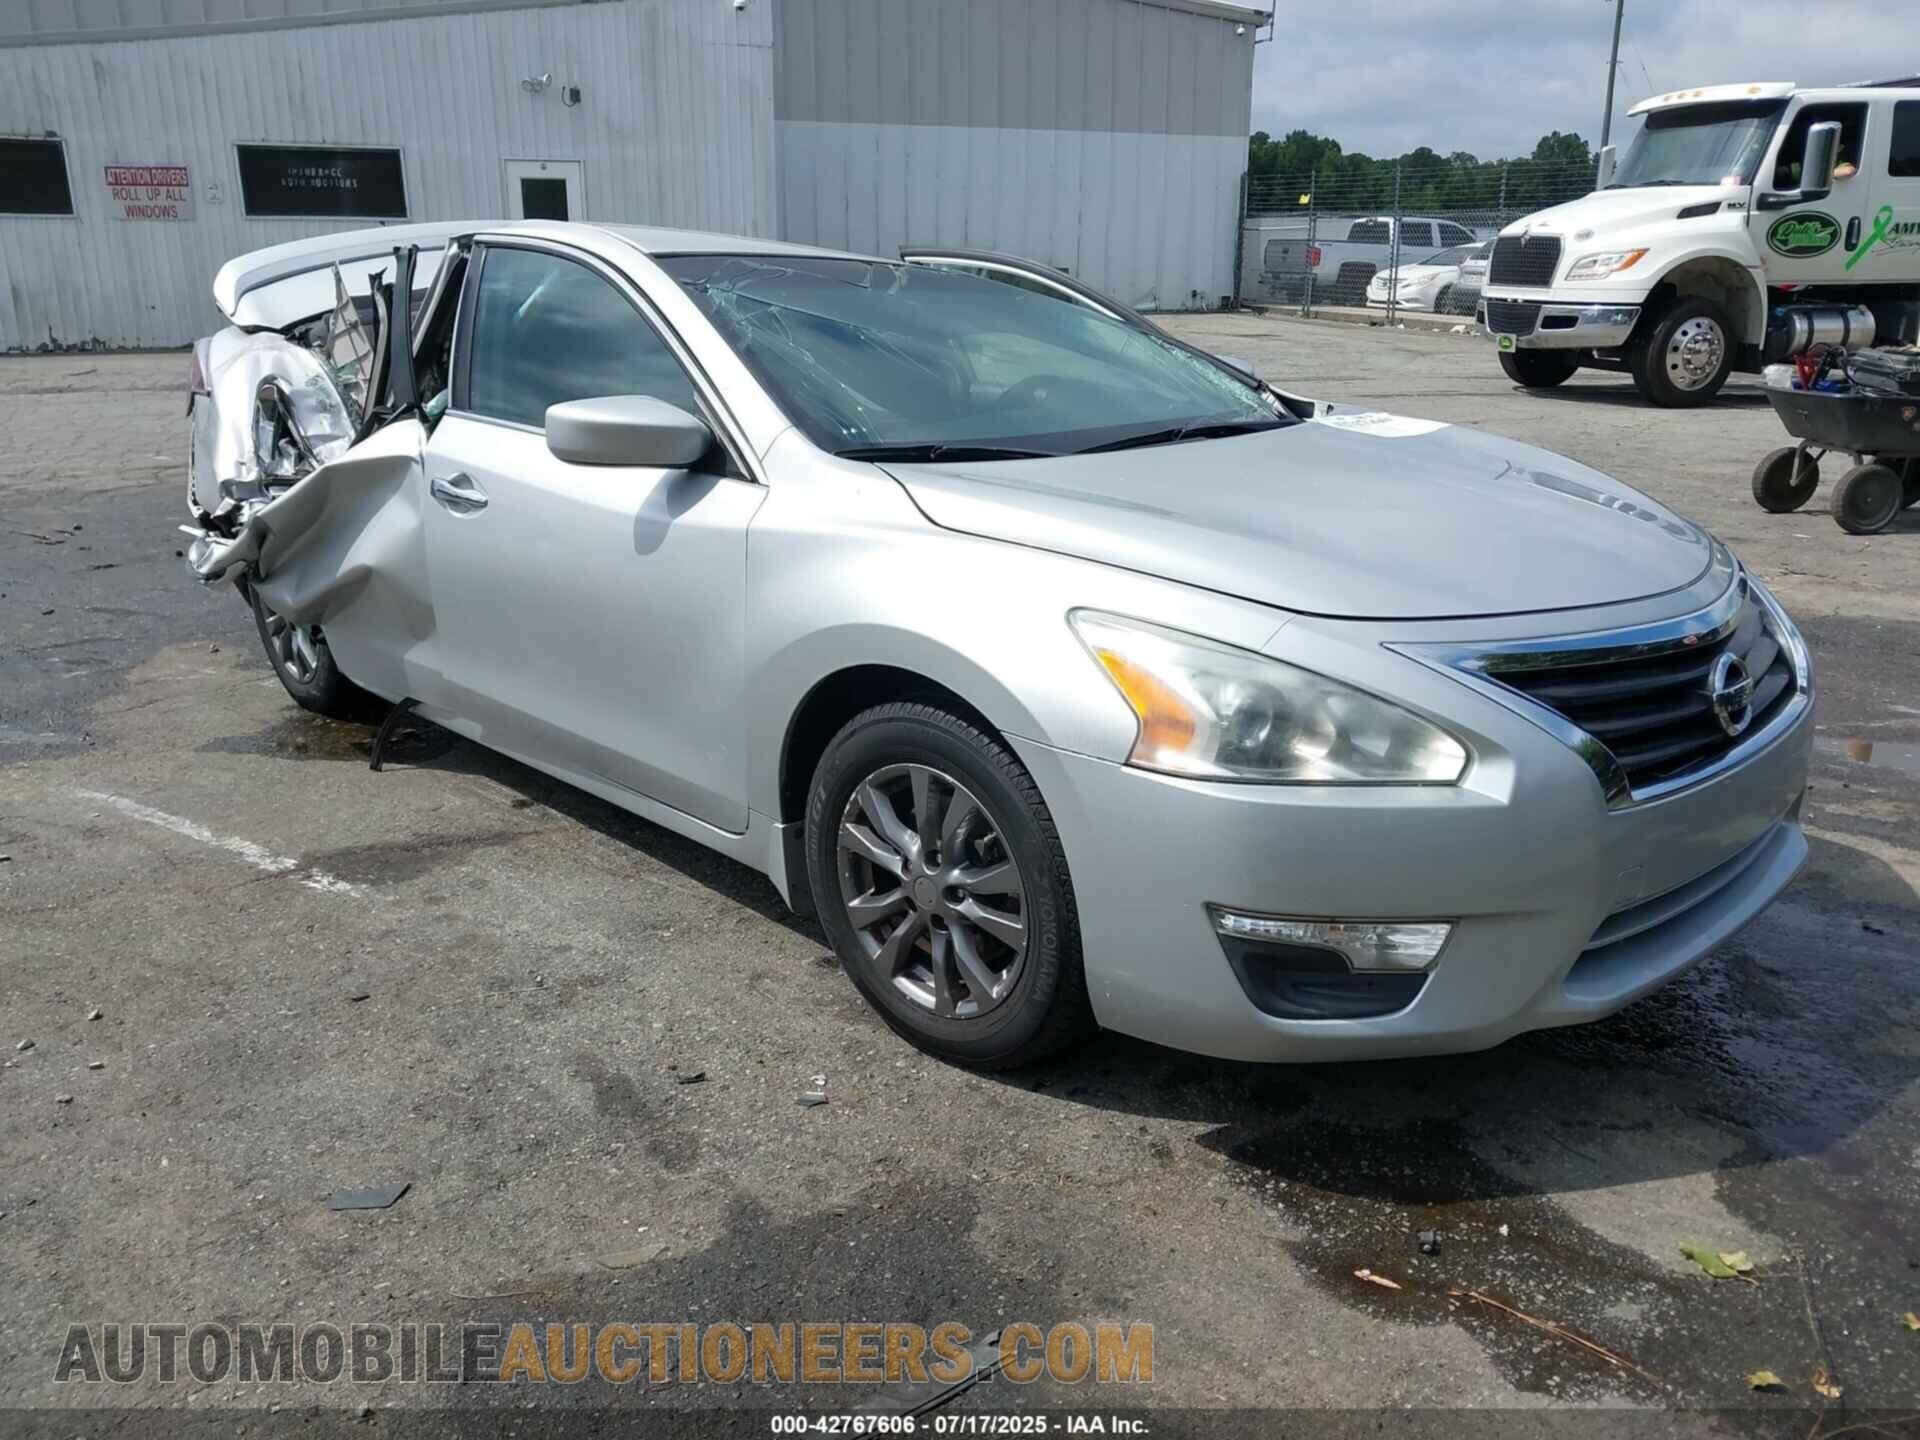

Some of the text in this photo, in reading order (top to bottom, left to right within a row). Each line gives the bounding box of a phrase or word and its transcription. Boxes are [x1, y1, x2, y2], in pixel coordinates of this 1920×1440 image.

[106, 168, 188, 185] ATTENTION DRIVERS
[112, 187, 187, 202] ROLL UP ALL
[125, 205, 179, 218] WINDOWS
